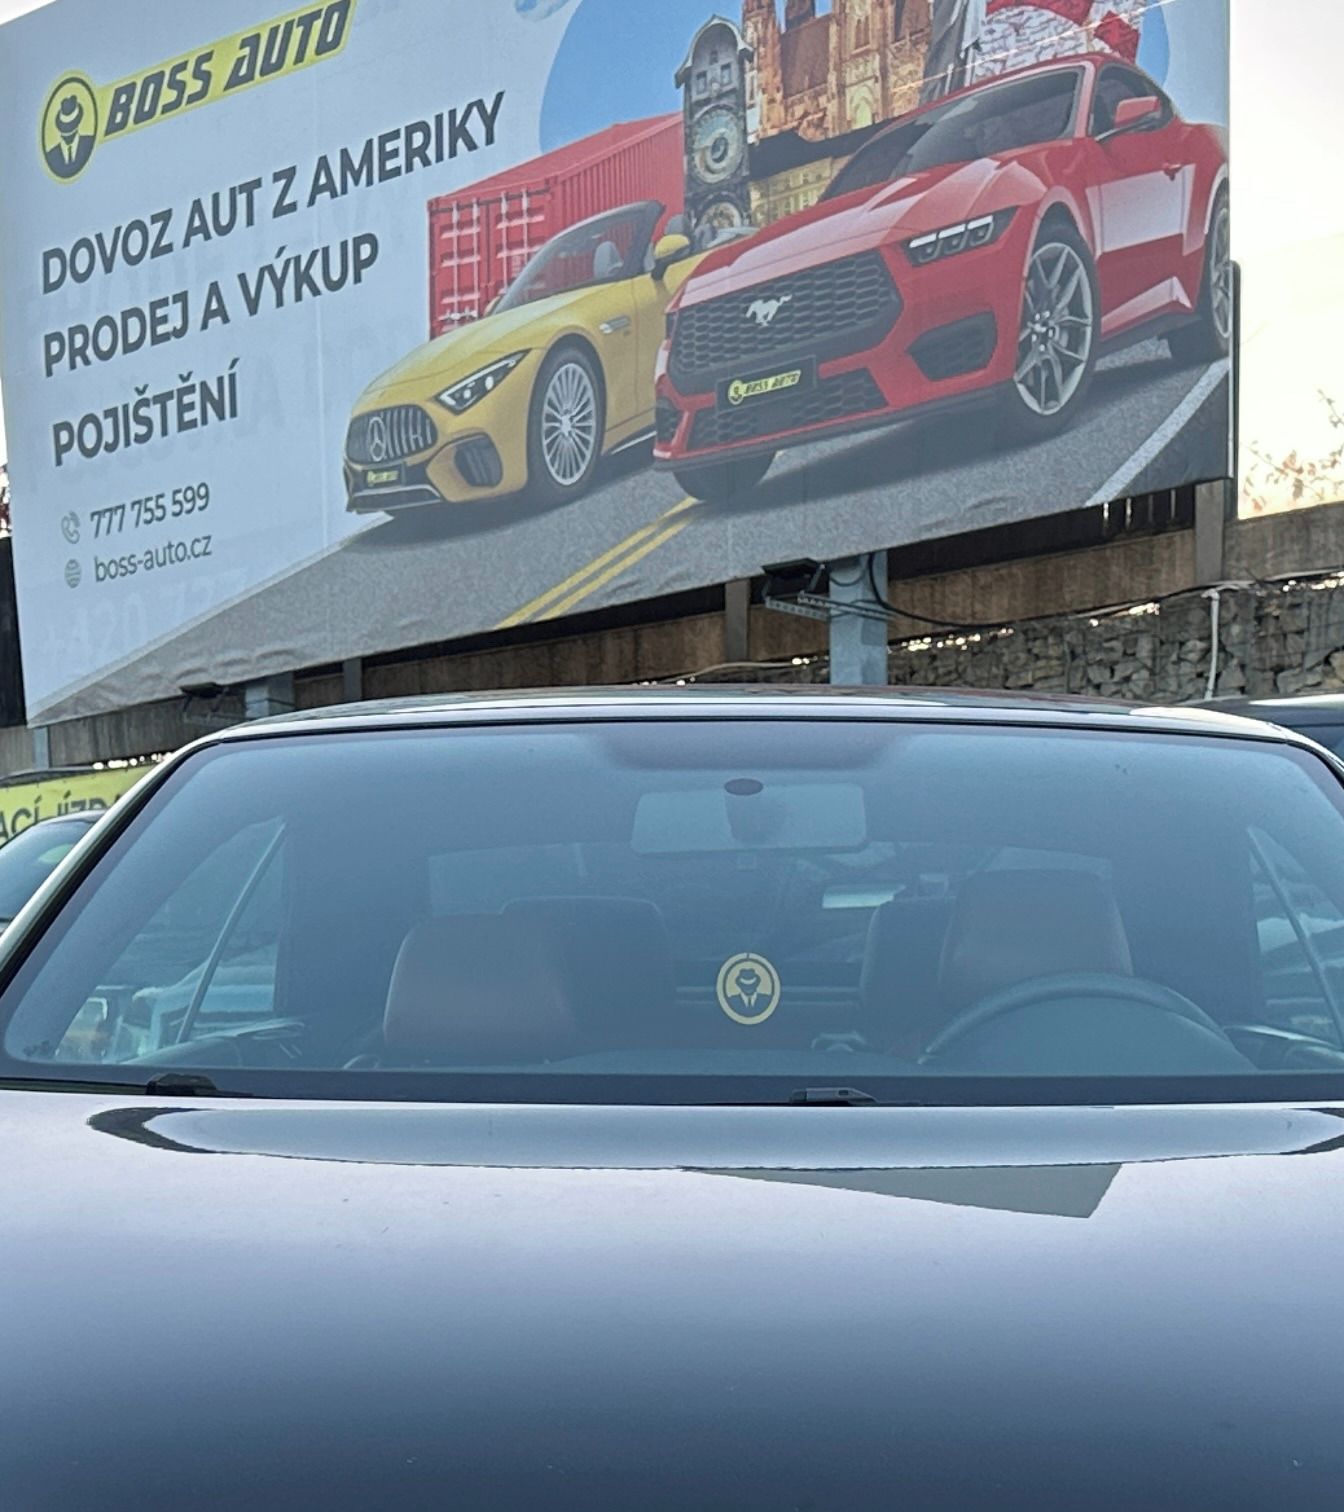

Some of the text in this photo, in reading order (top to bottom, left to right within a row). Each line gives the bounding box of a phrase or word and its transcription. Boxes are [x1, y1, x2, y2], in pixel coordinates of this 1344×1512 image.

[104, 0, 351, 137] BOSS AUTO
[42, 90, 506, 295] DOVOZ AUT Z AMERIKY
[43, 232, 380, 378] PRODEJ A VÝKUP
[52, 357, 241, 467] POJIŠTĚNÍ
[89, 482, 211, 540] 777 755 599
[93, 535, 214, 584] boss-auto.cz
